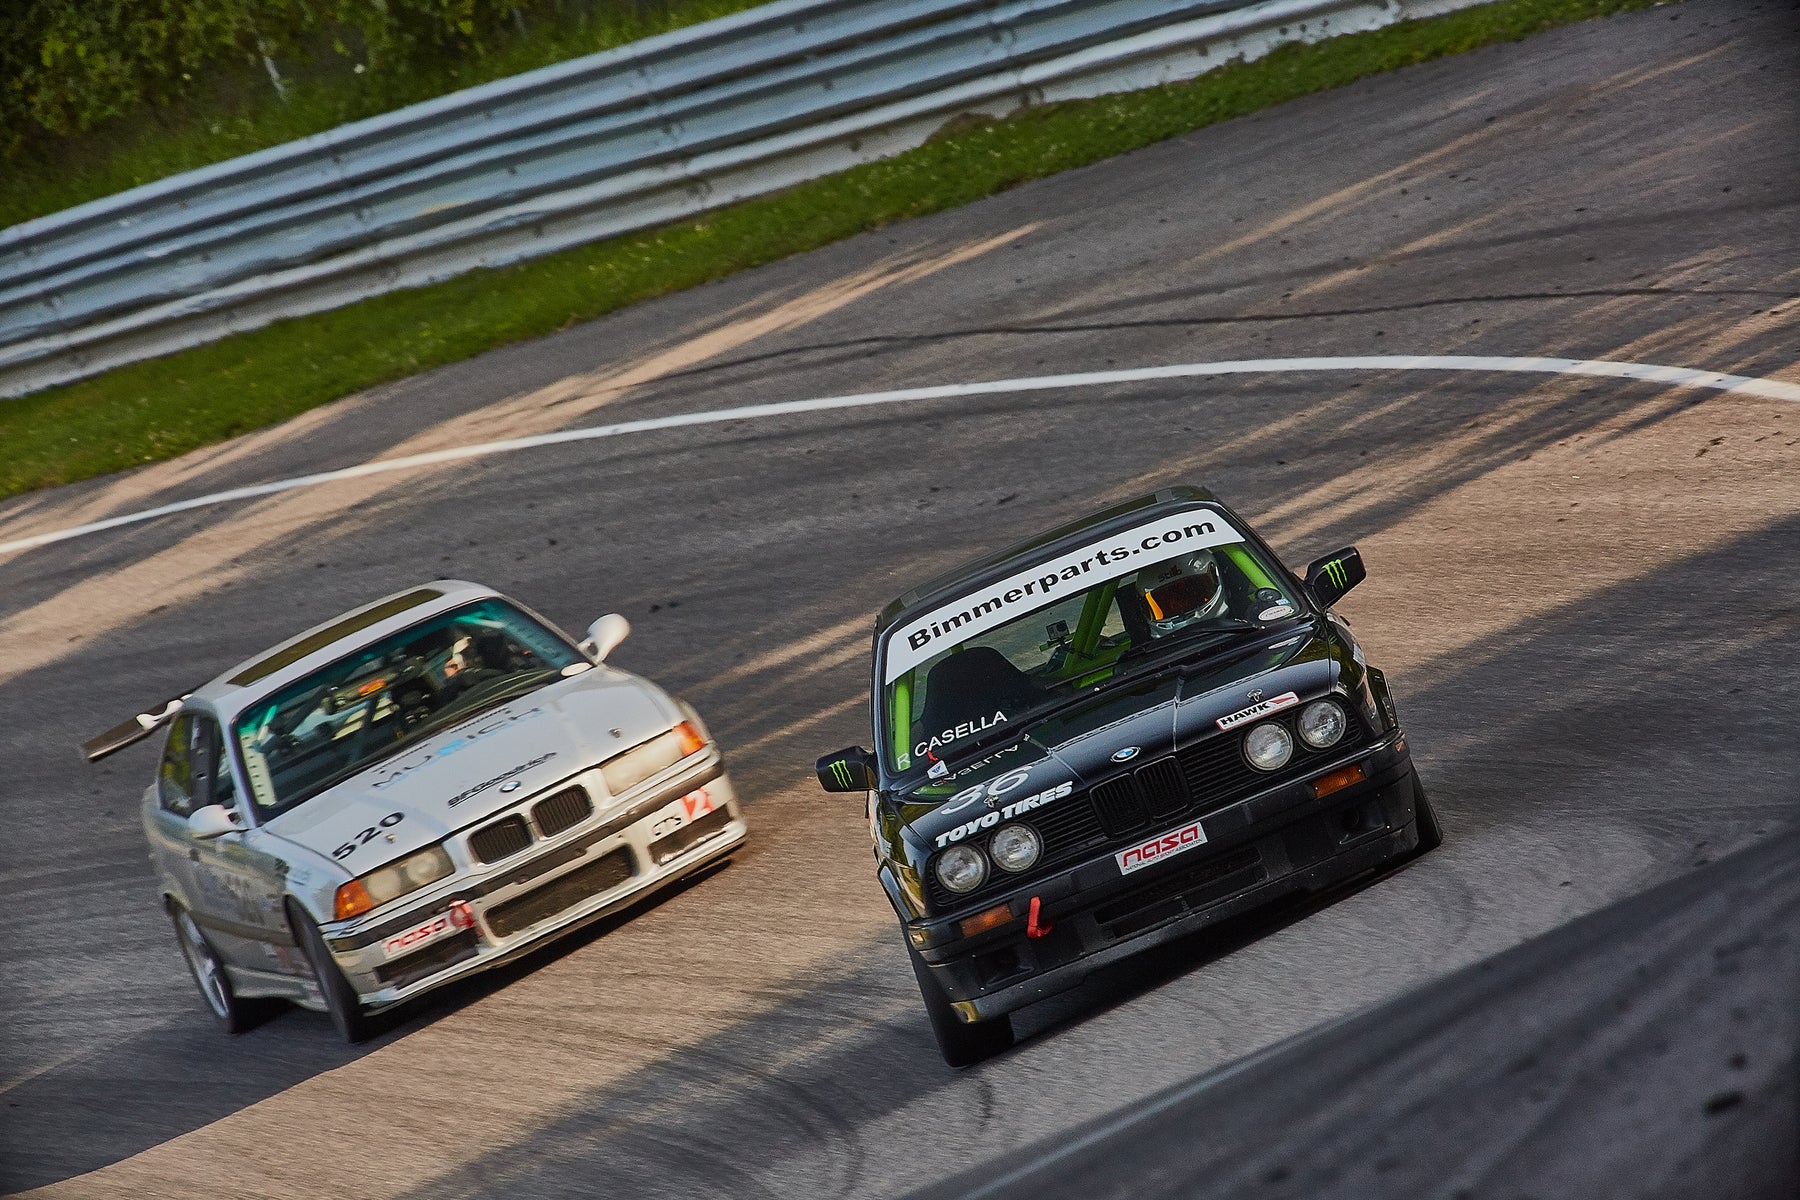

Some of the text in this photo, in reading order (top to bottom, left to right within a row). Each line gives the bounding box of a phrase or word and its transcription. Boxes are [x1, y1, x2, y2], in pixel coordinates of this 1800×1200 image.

[907, 521, 1216, 651] Bimmerparts.com
[914, 710, 1008, 757] CASELLA
[1219, 701, 1271, 726] HAWK
[332, 812, 405, 860] 520
[934, 780, 1074, 848] TOYO TIRES
[1122, 825, 1200, 868] nasa
